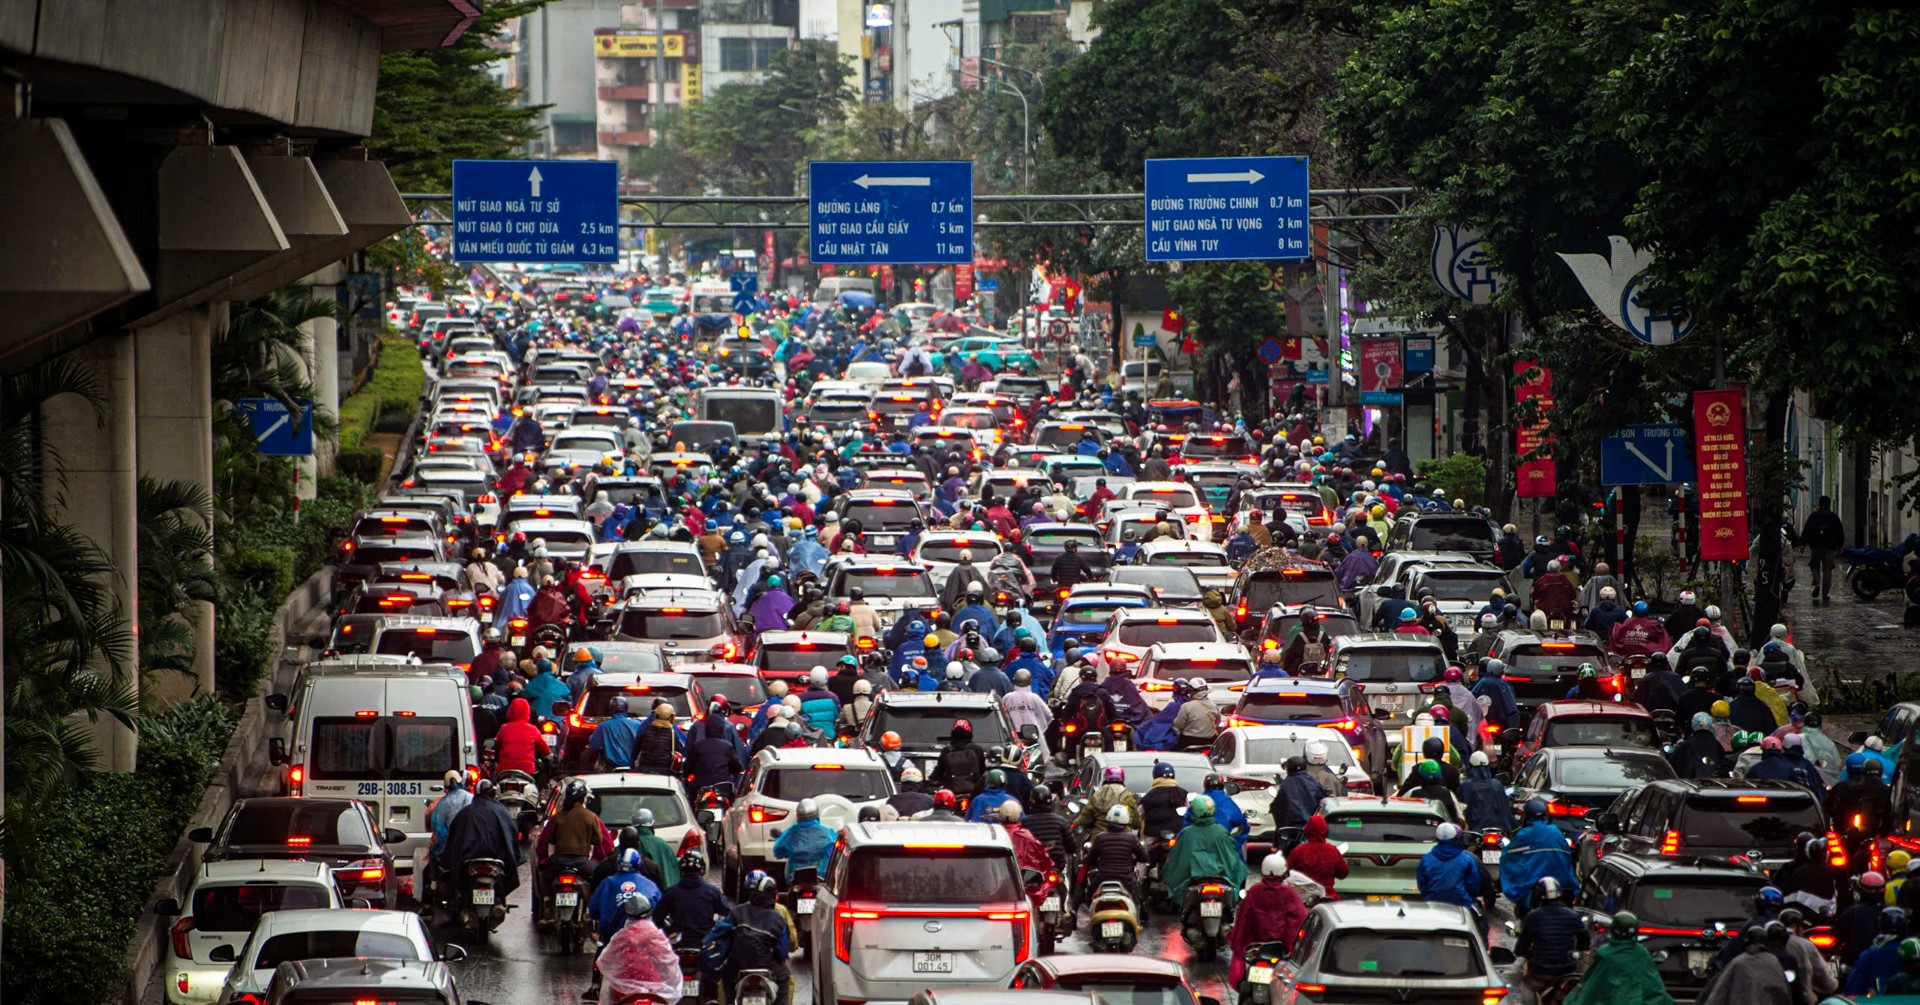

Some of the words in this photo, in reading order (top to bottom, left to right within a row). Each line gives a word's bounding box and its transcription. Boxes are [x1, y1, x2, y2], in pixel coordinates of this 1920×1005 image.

[457, 197, 476, 213] NÚT
[479, 200, 502, 213] GIAO
[506, 198, 525, 213] NGÃ
[530, 200, 542, 213] TƯ
[547, 197, 560, 213] SỞ
[818, 198, 851, 214] ĐƯỜNG
[854, 198, 880, 214] LÁNG
[931, 202, 945, 214] 0.7
[949, 201, 964, 213] km
[1151, 195, 1184, 211] ĐƯỜNG
[1188, 194, 1226, 210] TRƯỜNG
[1229, 197, 1258, 209] CHINH
[1269, 197, 1283, 209] 0.7
[1288, 196, 1303, 208] km
[458, 218, 476, 233] NÚT
[479, 221, 502, 233] GIAO
[506, 219, 512, 233] Ô
[516, 221, 535, 236] CHỢ
[539, 218, 559, 234] DỪA
[580, 222, 596, 235] 2.5
[599, 222, 614, 234] km
[818, 219, 837, 234] NÚT
[839, 222, 862, 234] GIAO
[865, 219, 884, 234] CẦU
[888, 218, 909, 235] GIẤY
[940, 222, 946, 234] 5
[949, 222, 964, 234] km
[1151, 217, 1170, 232] NÚT
[1173, 219, 1195, 231] GIAO
[1198, 216, 1217, 231] NGÃ
[1221, 218, 1233, 230] TƯ
[1236, 217, 1263, 232] VỌNG
[1278, 217, 1284, 229] 3
[1288, 217, 1303, 229] km
[458, 240, 478, 254] VĂN
[479, 238, 504, 254] MIẾU
[506, 238, 532, 255] QUỐC
[535, 239, 547, 254] TỬ
[550, 239, 575, 255] GIÁM
[599, 243, 614, 255] km
[818, 240, 837, 255] CẦU
[840, 241, 866, 257] NHẬT
[870, 240, 889, 255] TÂN
[936, 243, 946, 254] 11
[949, 243, 964, 255] km
[1152, 237, 1170, 253] CẦU
[1174, 238, 1197, 252] VĨNH
[1201, 239, 1219, 251] TUY
[1278, 238, 1284, 250] 8
[1288, 238, 1303, 249] km
[357, 782, 383, 795] 29B-
[387, 782, 422, 795] 308.51
[925, 952, 941, 962] 30M
[917, 962, 948, 971] 001.45
